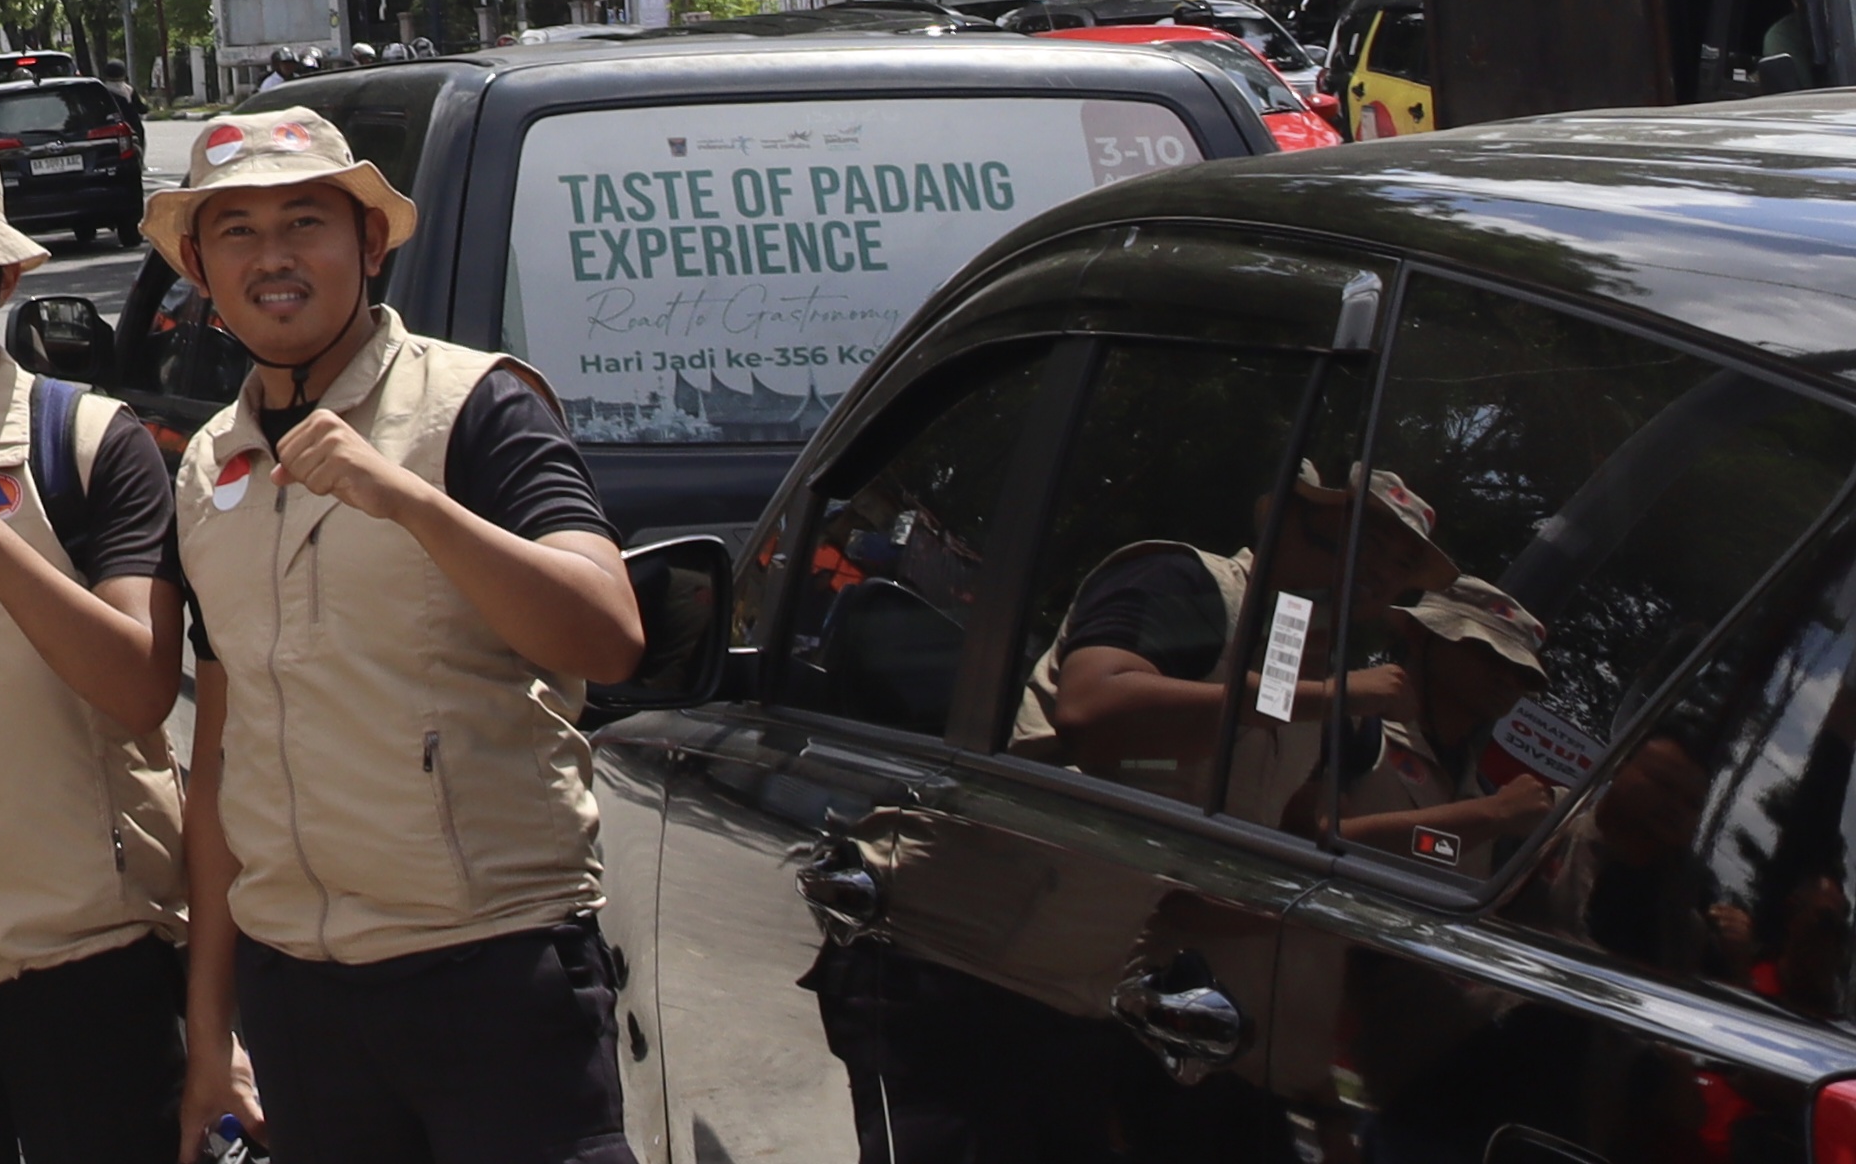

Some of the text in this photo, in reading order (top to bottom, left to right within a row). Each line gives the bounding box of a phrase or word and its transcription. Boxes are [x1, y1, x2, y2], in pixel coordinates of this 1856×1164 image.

[1094, 135, 1185, 167] 3-10
[558, 160, 1015, 224] TASTE OF PADANG
[568, 220, 888, 282] EXPERIENCE
[586, 287, 681, 339] Road
[580, 344, 877, 374] Hari Jadi ke-356 Ko
